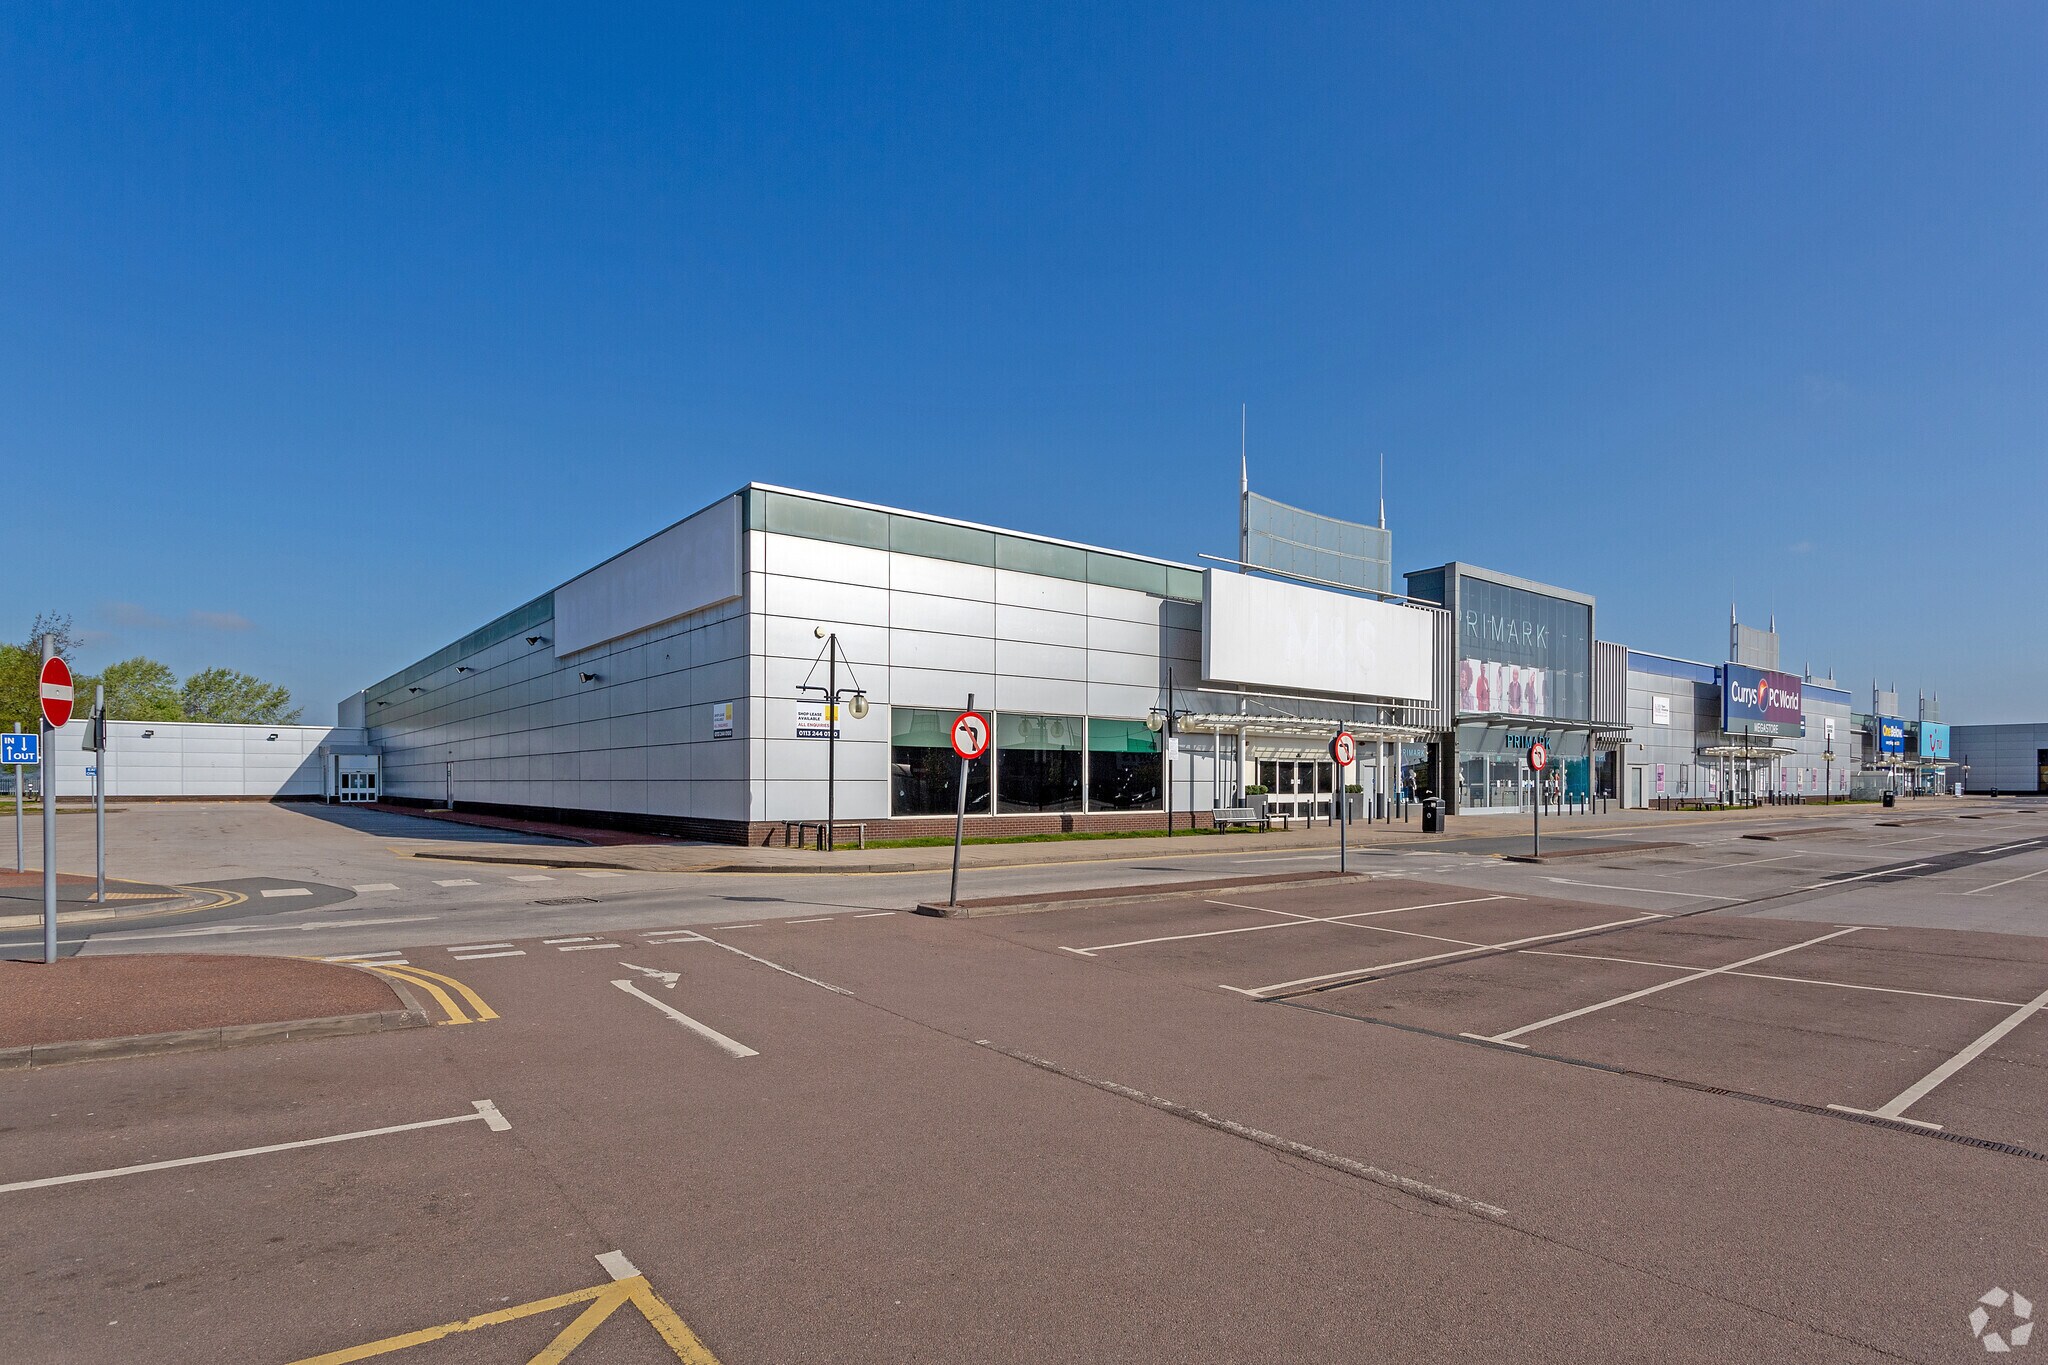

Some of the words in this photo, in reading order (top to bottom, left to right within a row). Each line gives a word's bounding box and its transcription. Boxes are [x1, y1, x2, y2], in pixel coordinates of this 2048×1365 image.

[1459, 609, 1547, 649] RIMARK
[1731, 681, 1757, 708] Currys
[1768, 688, 1779, 708] PC
[1780, 690, 1799, 710] World
[1753, 722, 1779, 734] MEGASTORE
[13, 752, 35, 760] OUT
[1402, 749, 1425, 757] RIMARK
